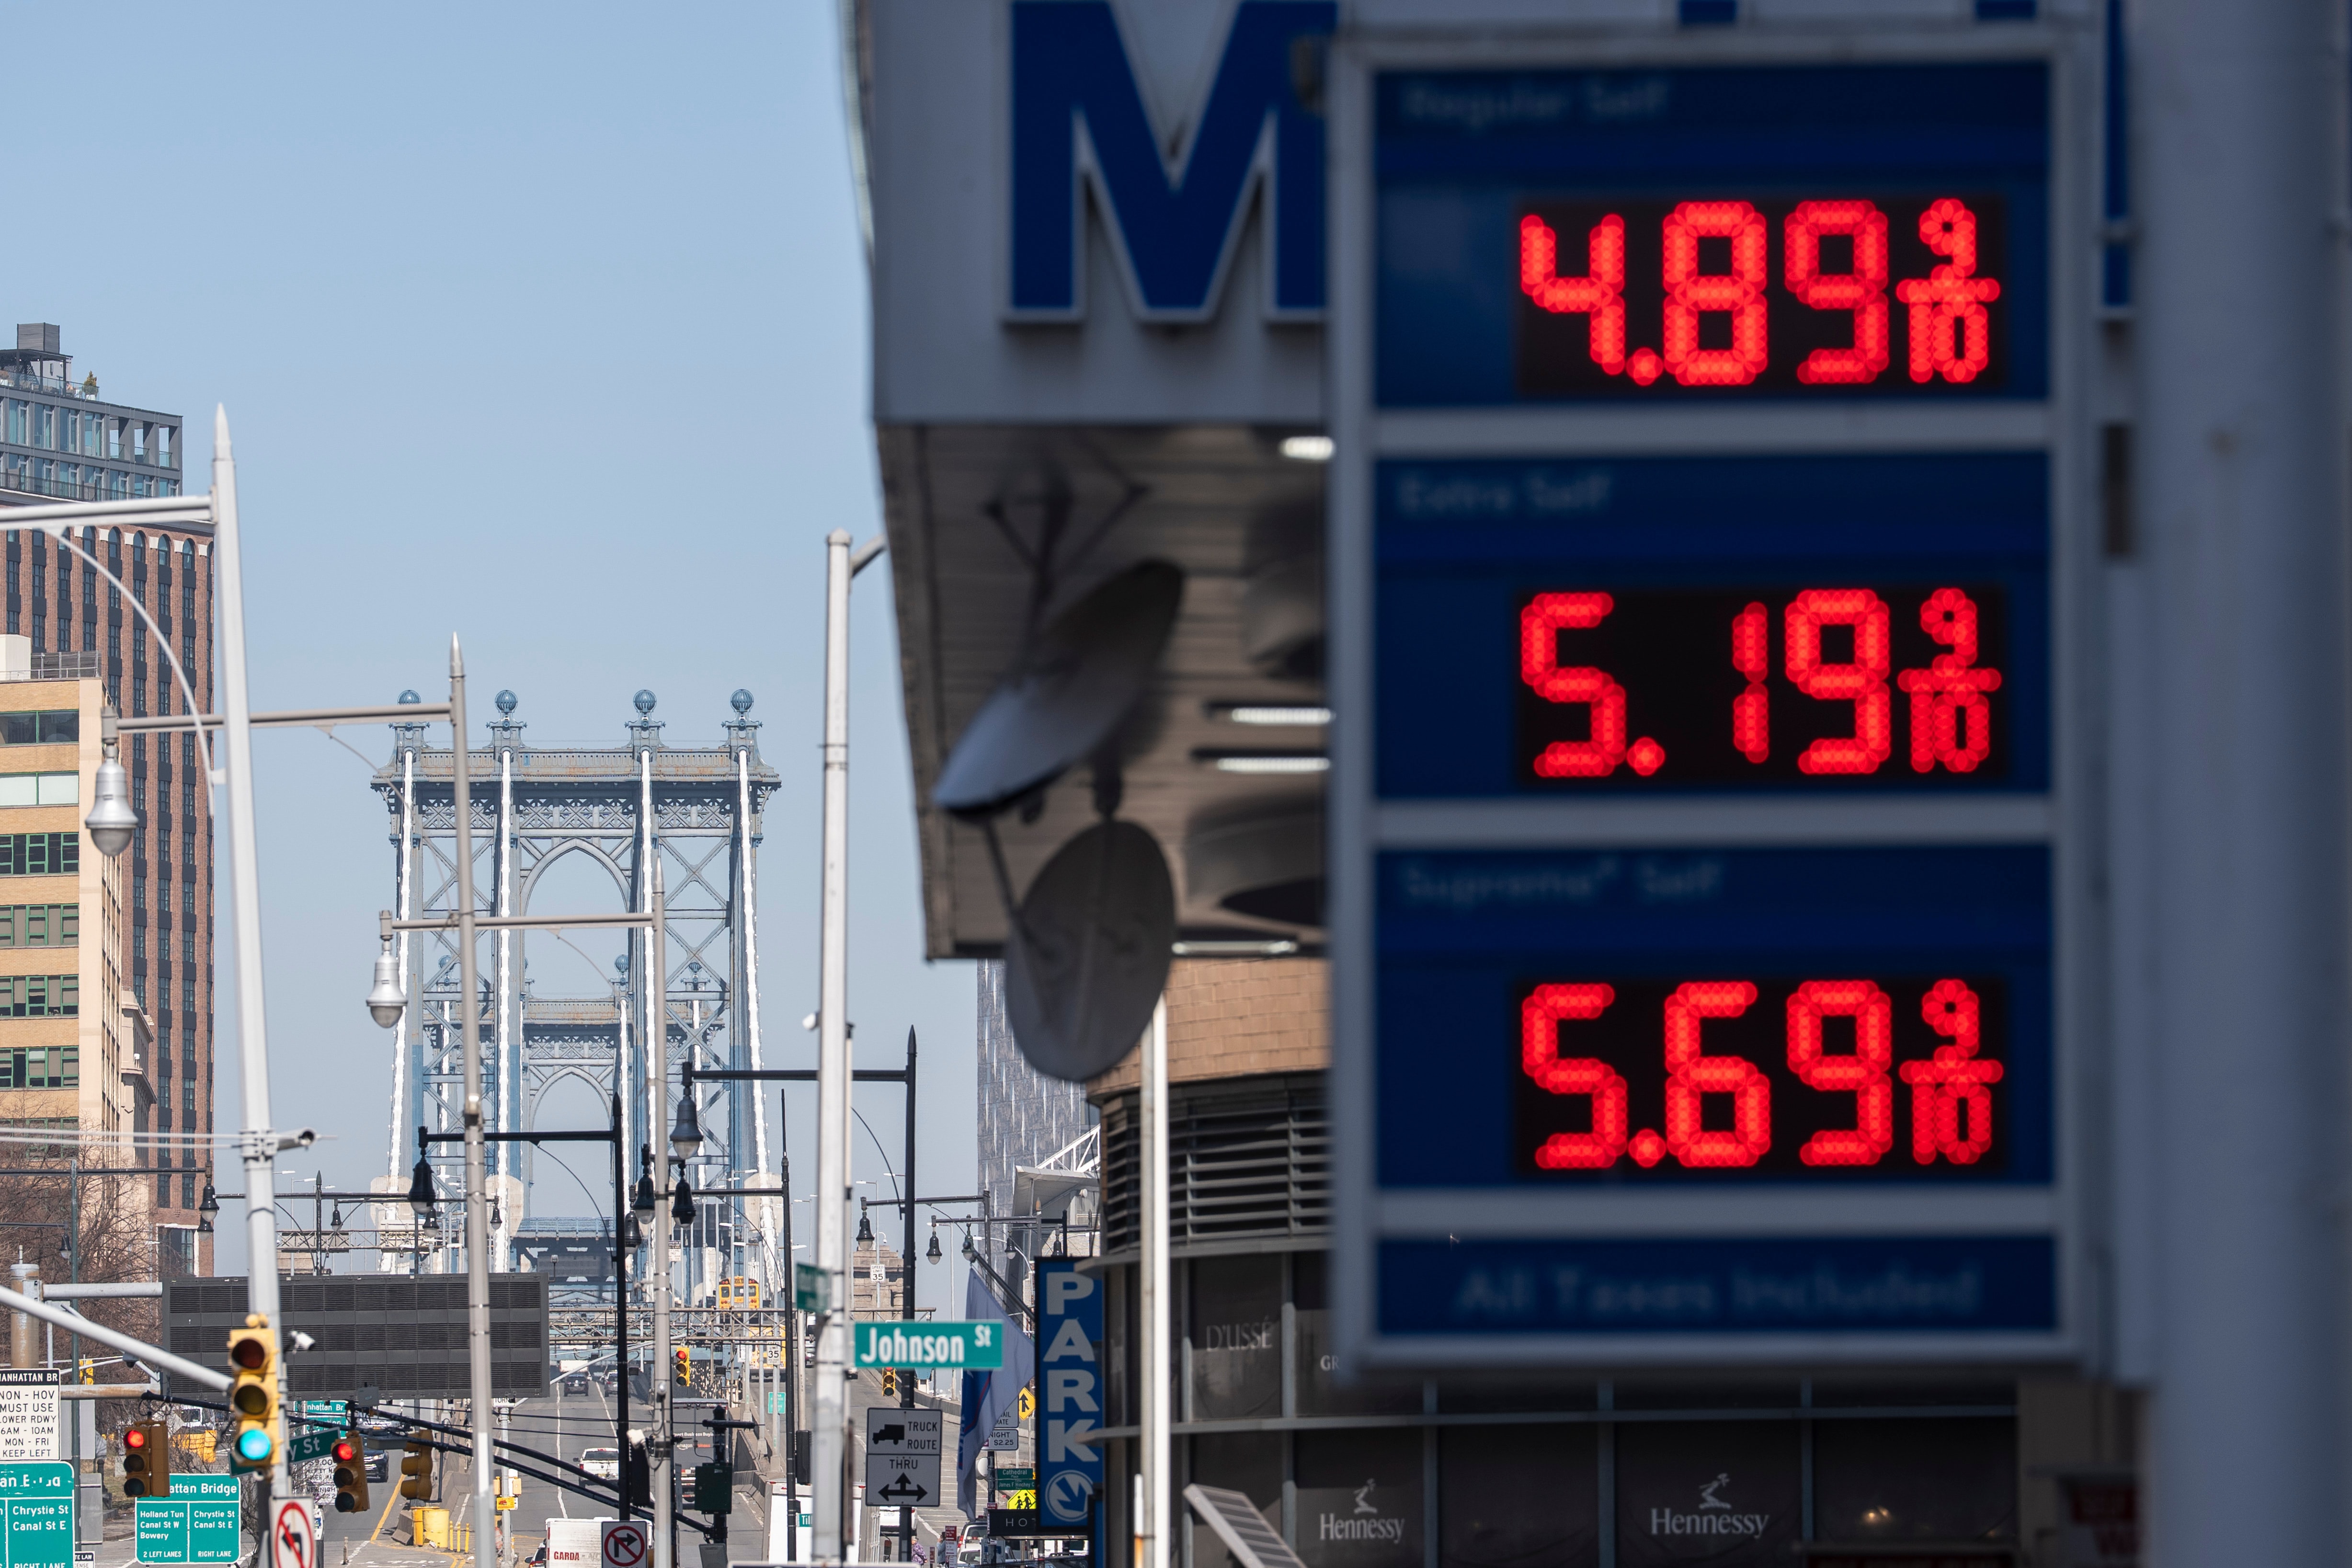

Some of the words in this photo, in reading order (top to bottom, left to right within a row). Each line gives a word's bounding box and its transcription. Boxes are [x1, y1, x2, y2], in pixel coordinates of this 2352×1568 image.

[1459, 1266, 1533, 1313] All
[1730, 1264, 1982, 1313] Included
[860, 1327, 965, 1363] Johnson
[975, 1324, 992, 1347] St
[768, 1350, 779, 1358] 35
[1043, 1272, 1100, 1463] PARK
[1320, 1355, 1340, 1372] GR
[46, 1373, 58, 1382] BR
[33, 1390, 55, 1399] HOV
[0, 1403, 28, 1412] MUST
[33, 1403, 54, 1412] USE
[908, 1421, 937, 1431] TRUCK
[303, 1437, 320, 1454] St
[907, 1439, 937, 1450] ROUTE
[890, 1459, 918, 1469] THRU
[170, 1484, 196, 1494] attan
[201, 1483, 238, 1496] Bridge
[12, 1506, 55, 1517] Chrystie
[58, 1505, 69, 1514] St
[194, 1510, 225, 1519] Chrystie
[12, 1522, 42, 1531] Canal
[46, 1521, 56, 1530] St
[59, 1521, 66, 1530] E
[1650, 1508, 1770, 1539] Hennessy
[1319, 1513, 1405, 1545] Hennessy
[140, 1532, 169, 1541] Bowery
[554, 1551, 580, 1561] GARDA
